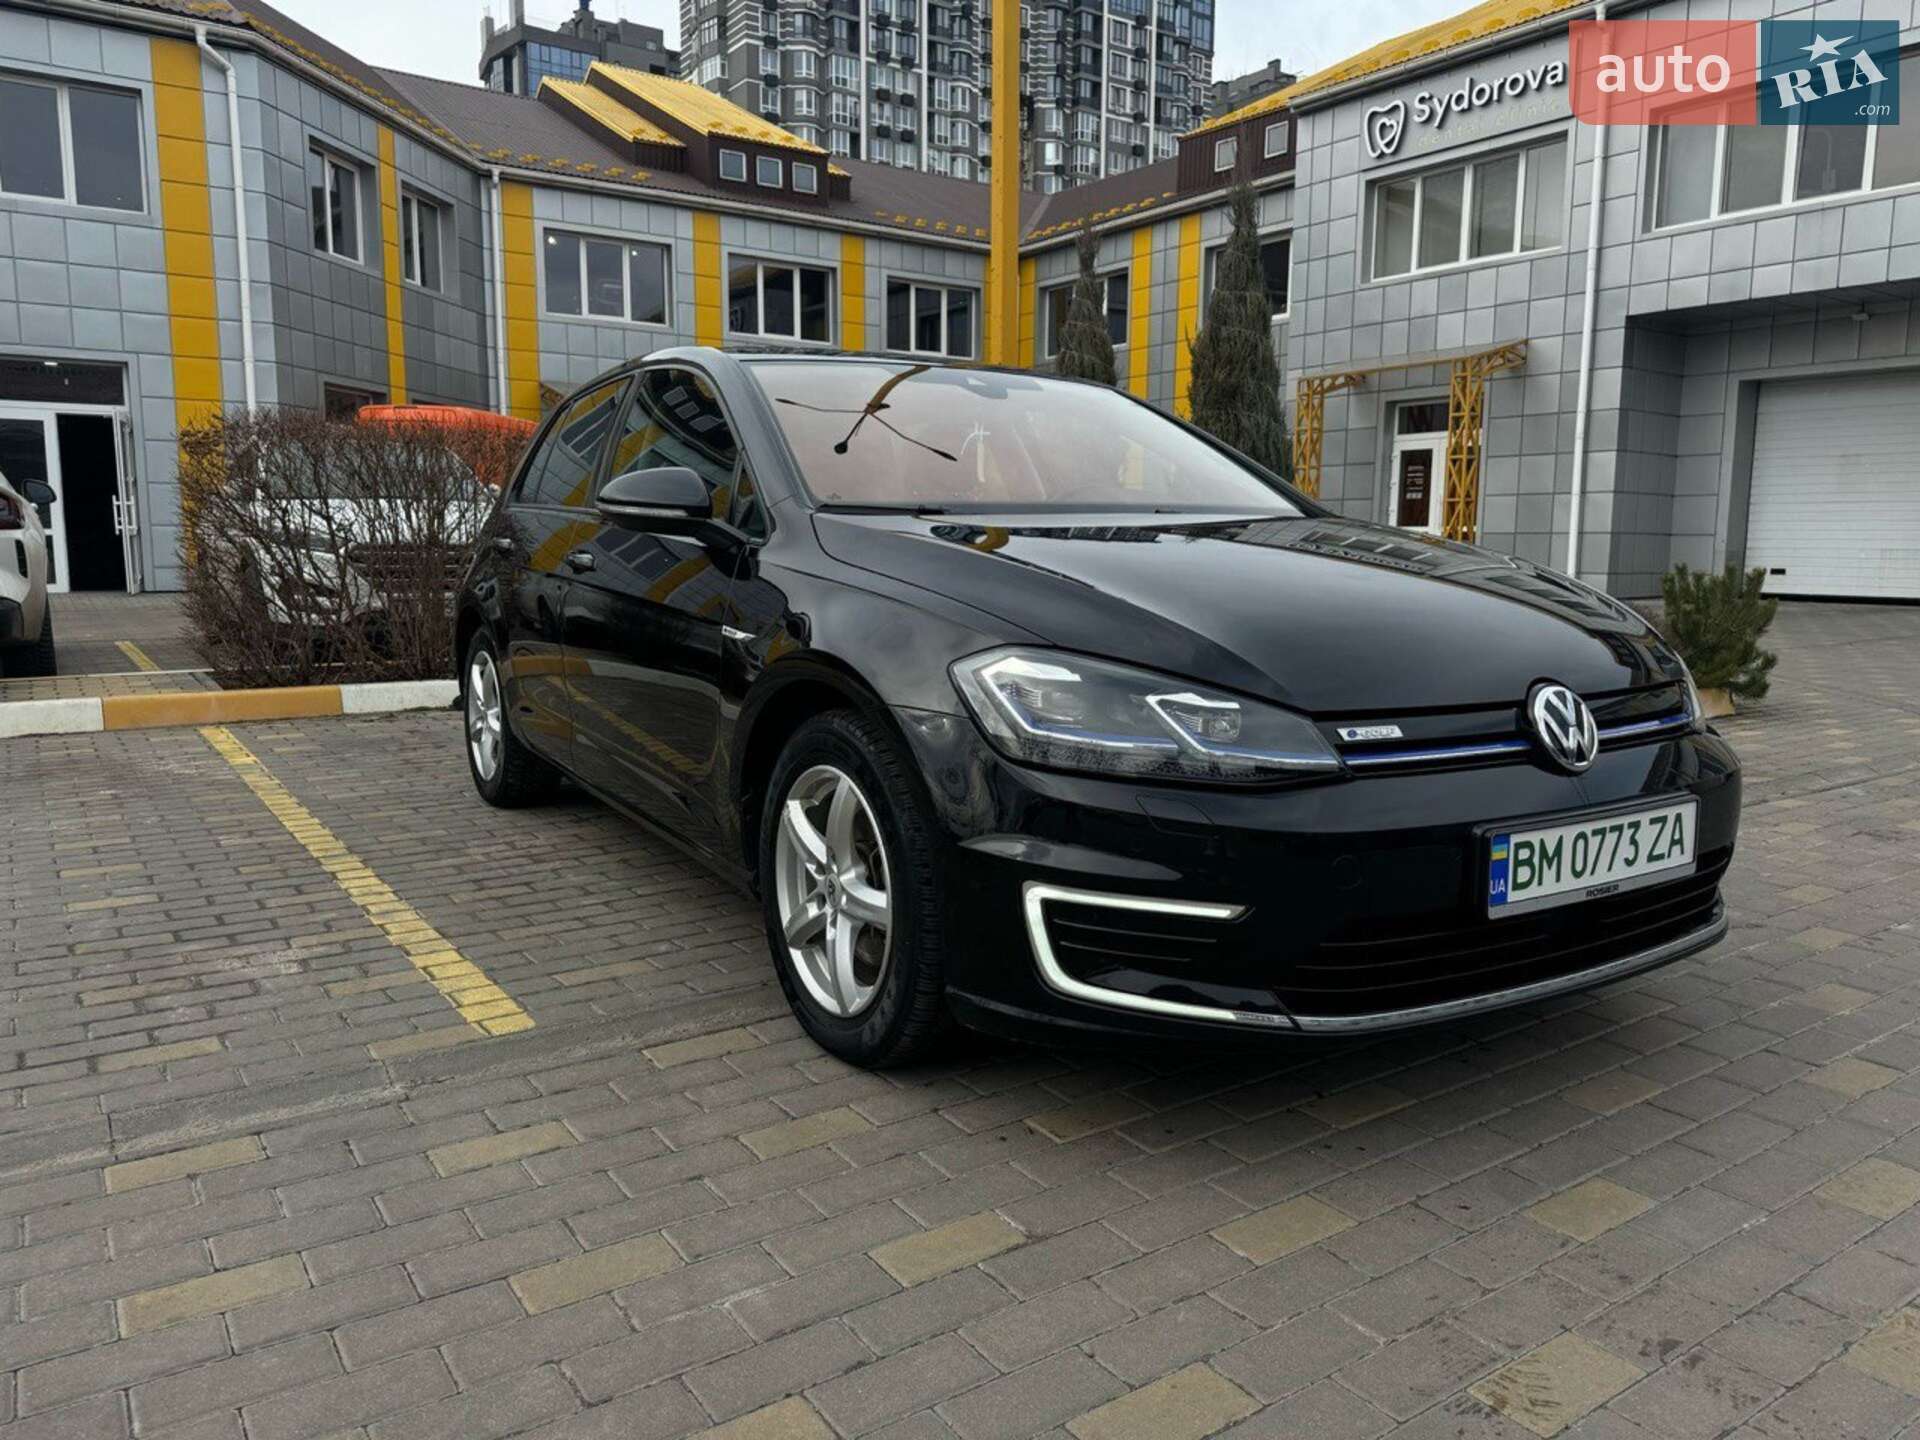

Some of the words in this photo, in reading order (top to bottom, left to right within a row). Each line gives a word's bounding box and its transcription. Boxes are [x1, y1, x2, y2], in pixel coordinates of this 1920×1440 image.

[1413, 60, 1566, 127] Sydorova
[1511, 834, 1564, 892] BM
[1570, 820, 1642, 879] 0773
[1646, 812, 1685, 864] ZA
[1489, 879, 1506, 895] UA
